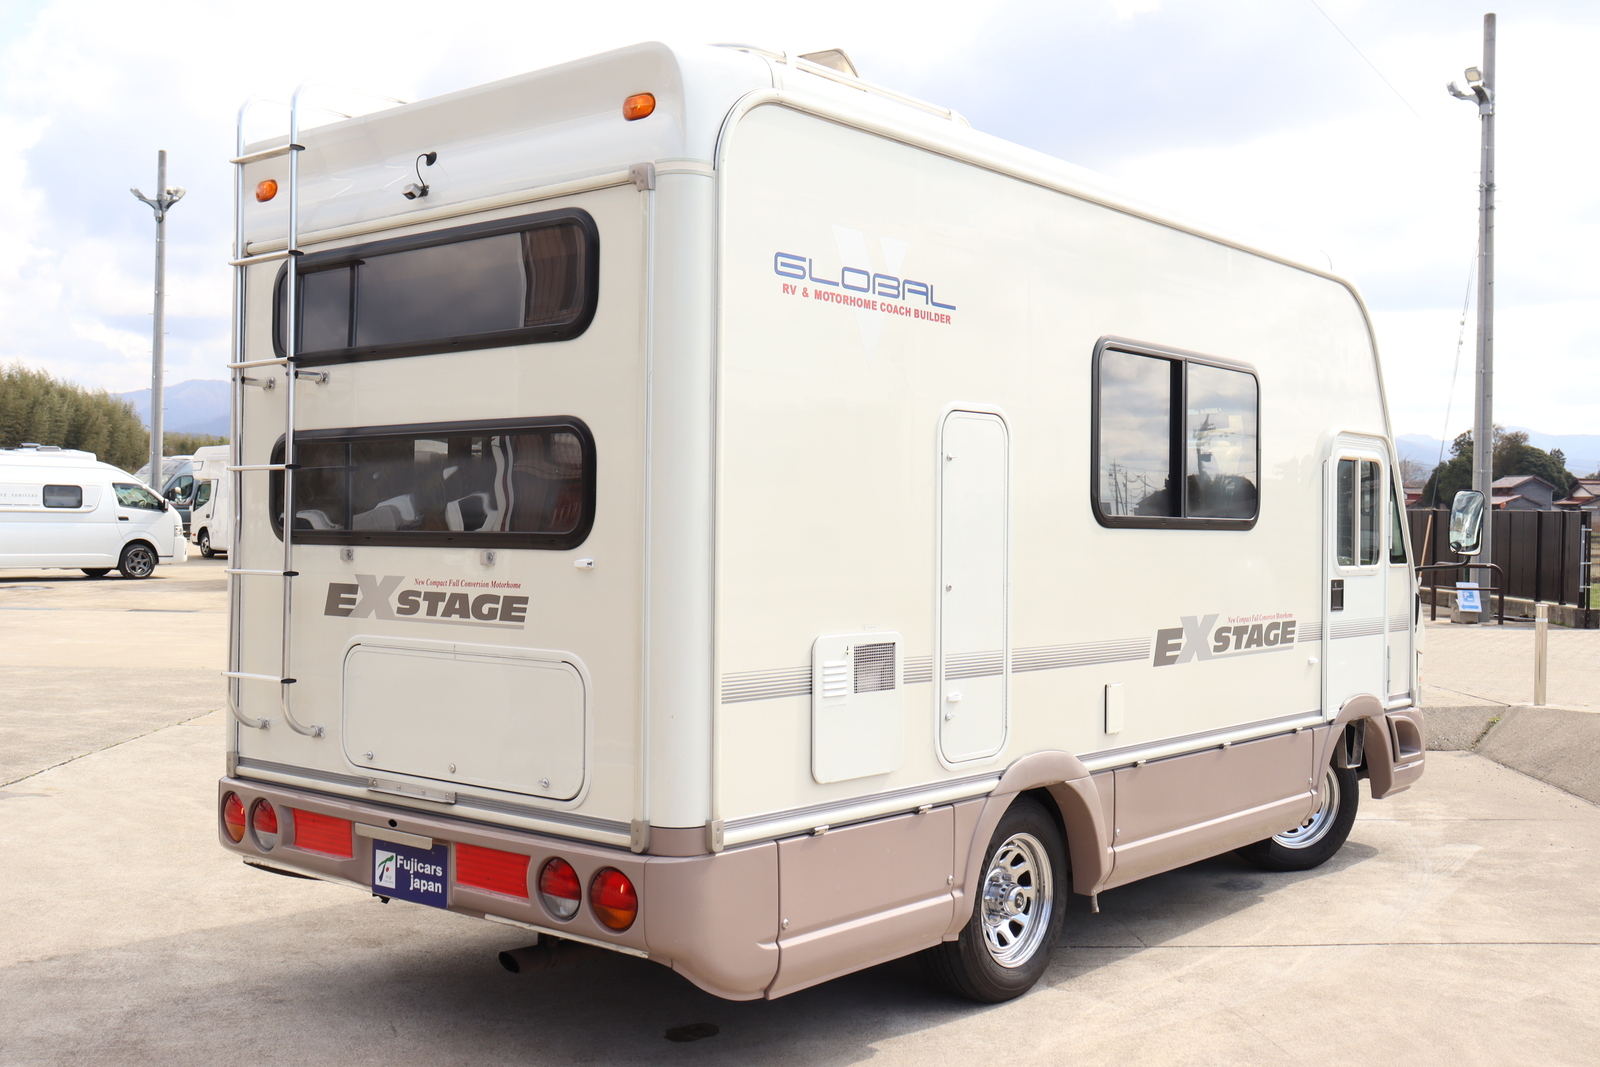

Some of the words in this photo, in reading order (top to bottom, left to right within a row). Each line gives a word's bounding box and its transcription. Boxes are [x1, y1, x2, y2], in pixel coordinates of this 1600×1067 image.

[774, 252, 956, 310] GLOBAL
[782, 283, 797, 295] RV
[802, 287, 809, 297] &
[814, 289, 877, 311] MOTORHOME
[880, 302, 911, 317] COACH
[914, 308, 951, 325] BUILDER
[414, 578, 424, 586] New
[426, 578, 447, 588] Compact
[448, 579, 459, 587] Full
[460, 579, 489, 588] Conversion
[490, 580, 521, 589] Motorhome
[397, 855, 443, 877] Fujicars
[409, 874, 442, 893] japan
